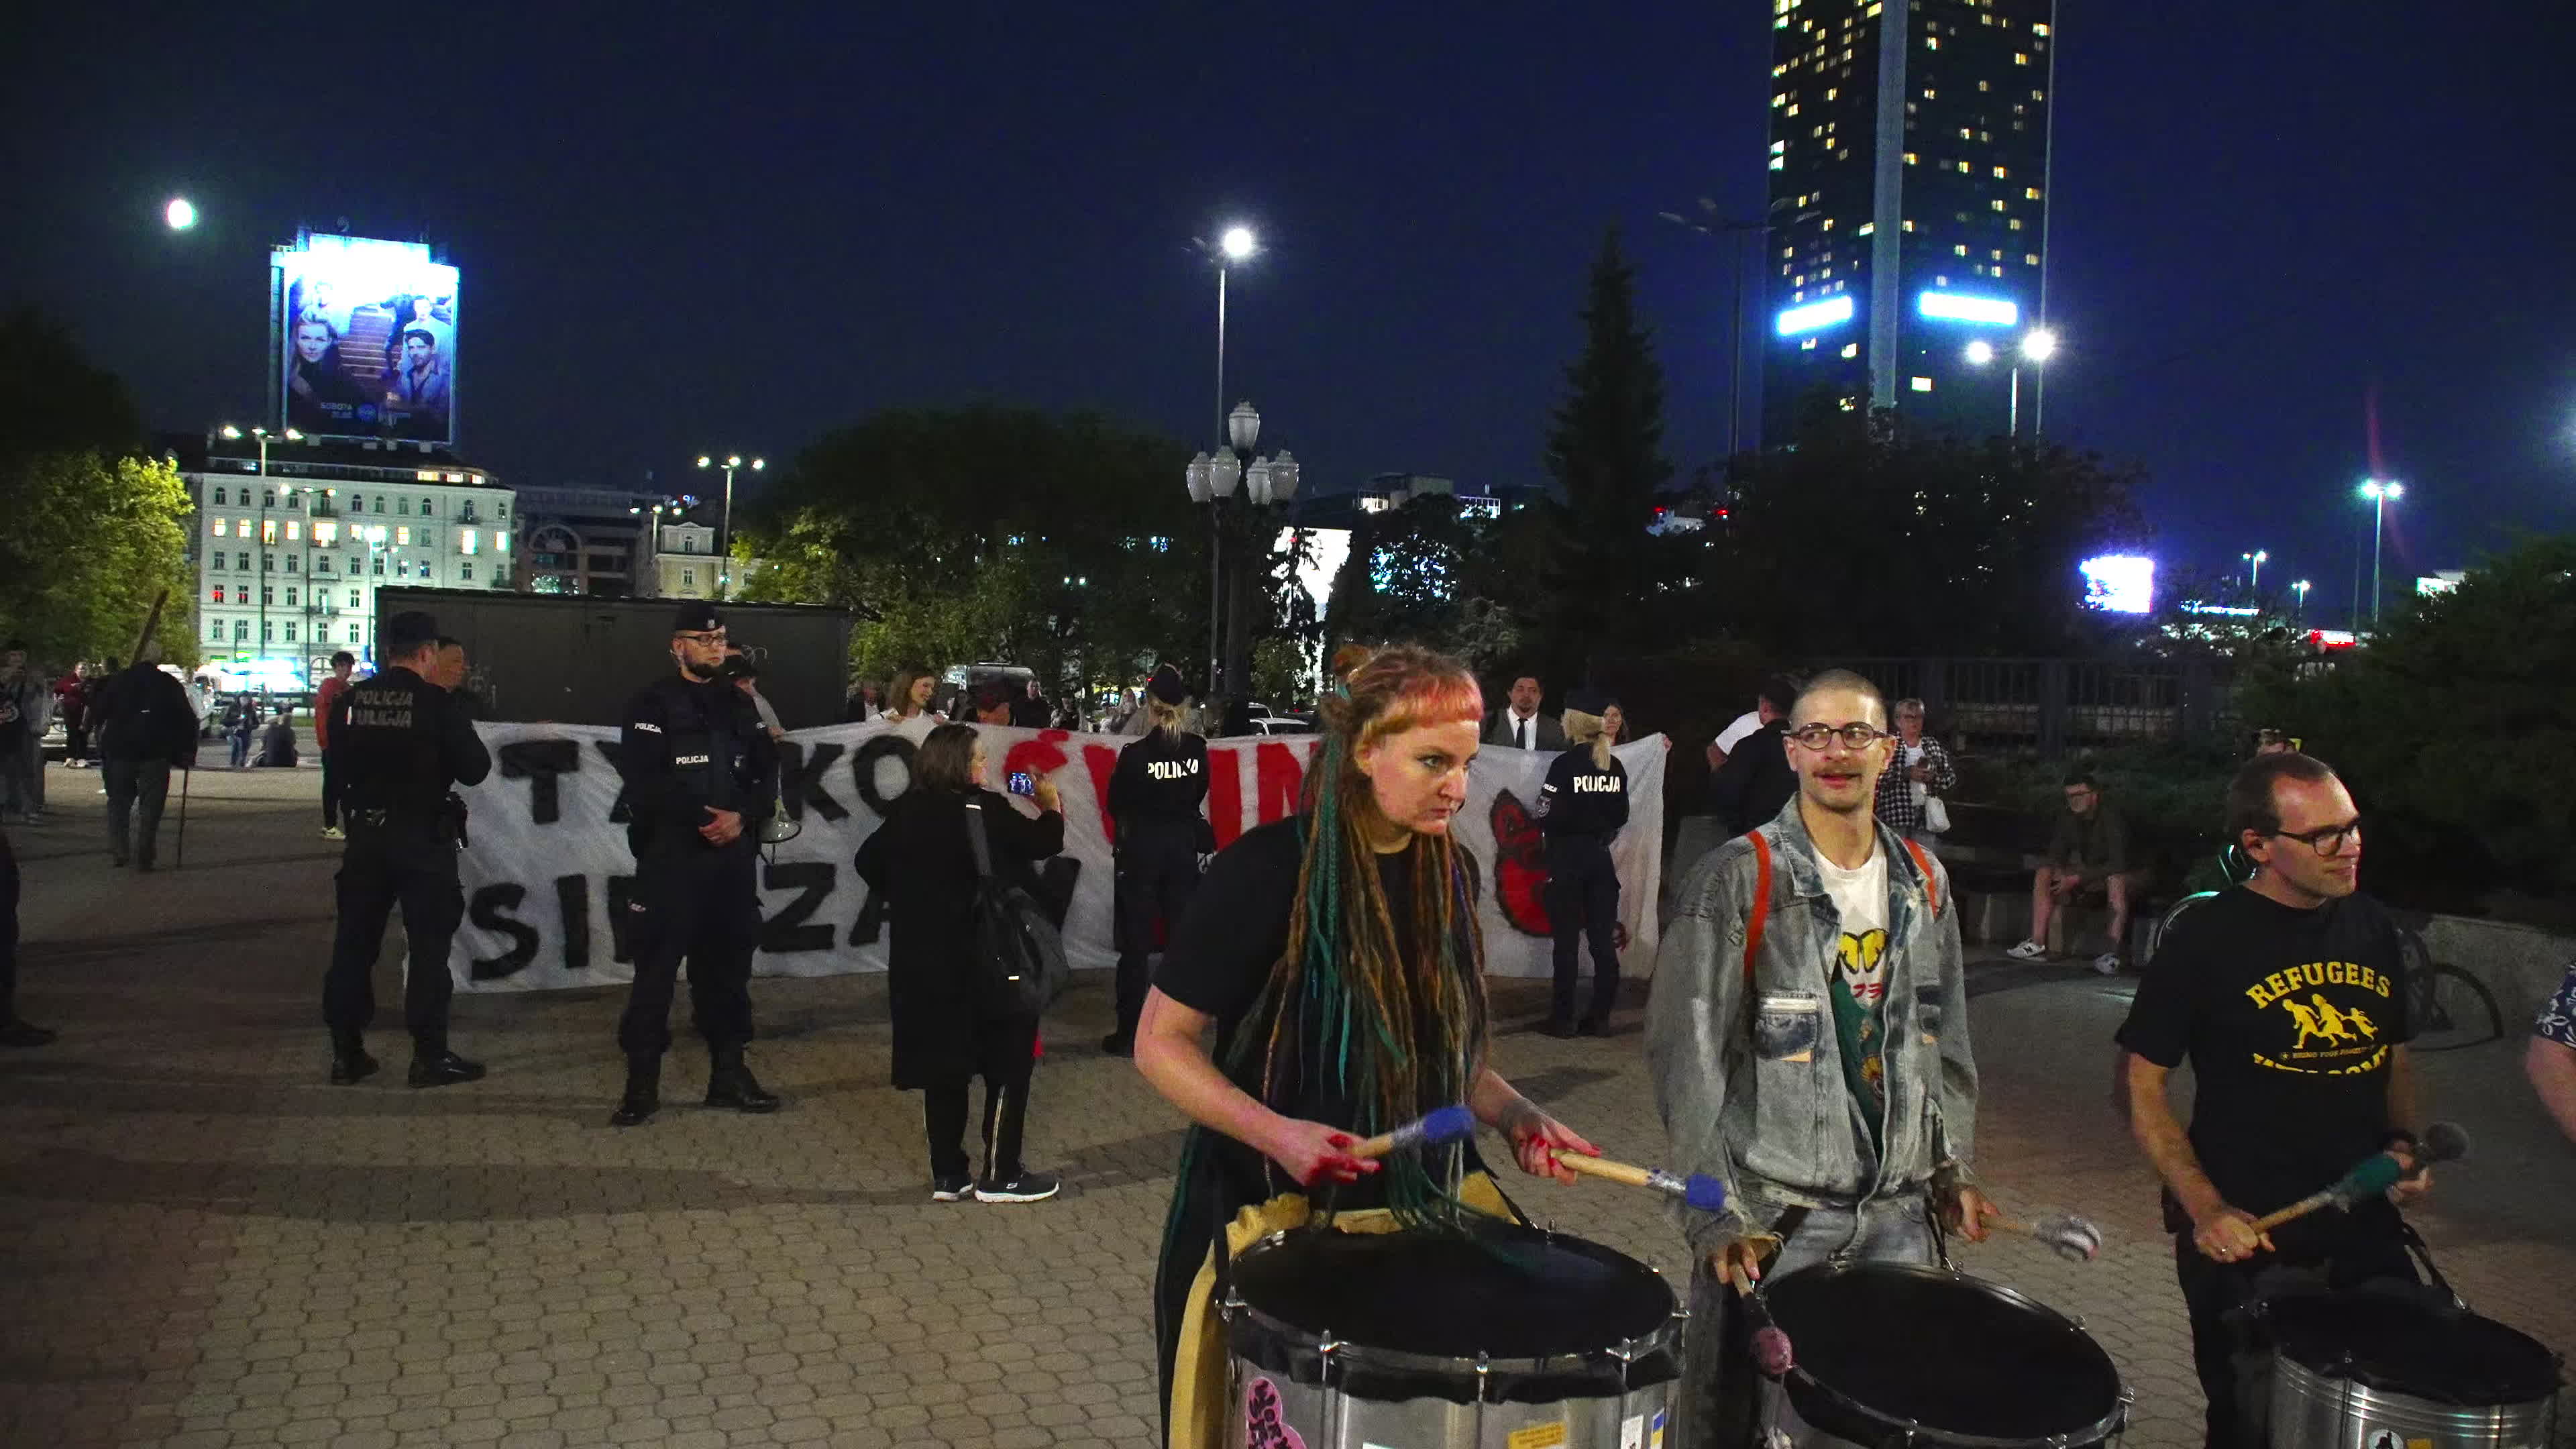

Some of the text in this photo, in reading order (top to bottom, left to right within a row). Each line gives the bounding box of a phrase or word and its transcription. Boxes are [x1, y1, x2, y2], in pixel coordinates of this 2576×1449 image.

[676, 755, 709, 765] POLICJA
[1573, 775, 1621, 794] POLICJA
[2245, 961, 2391, 1009] REFUGEES
